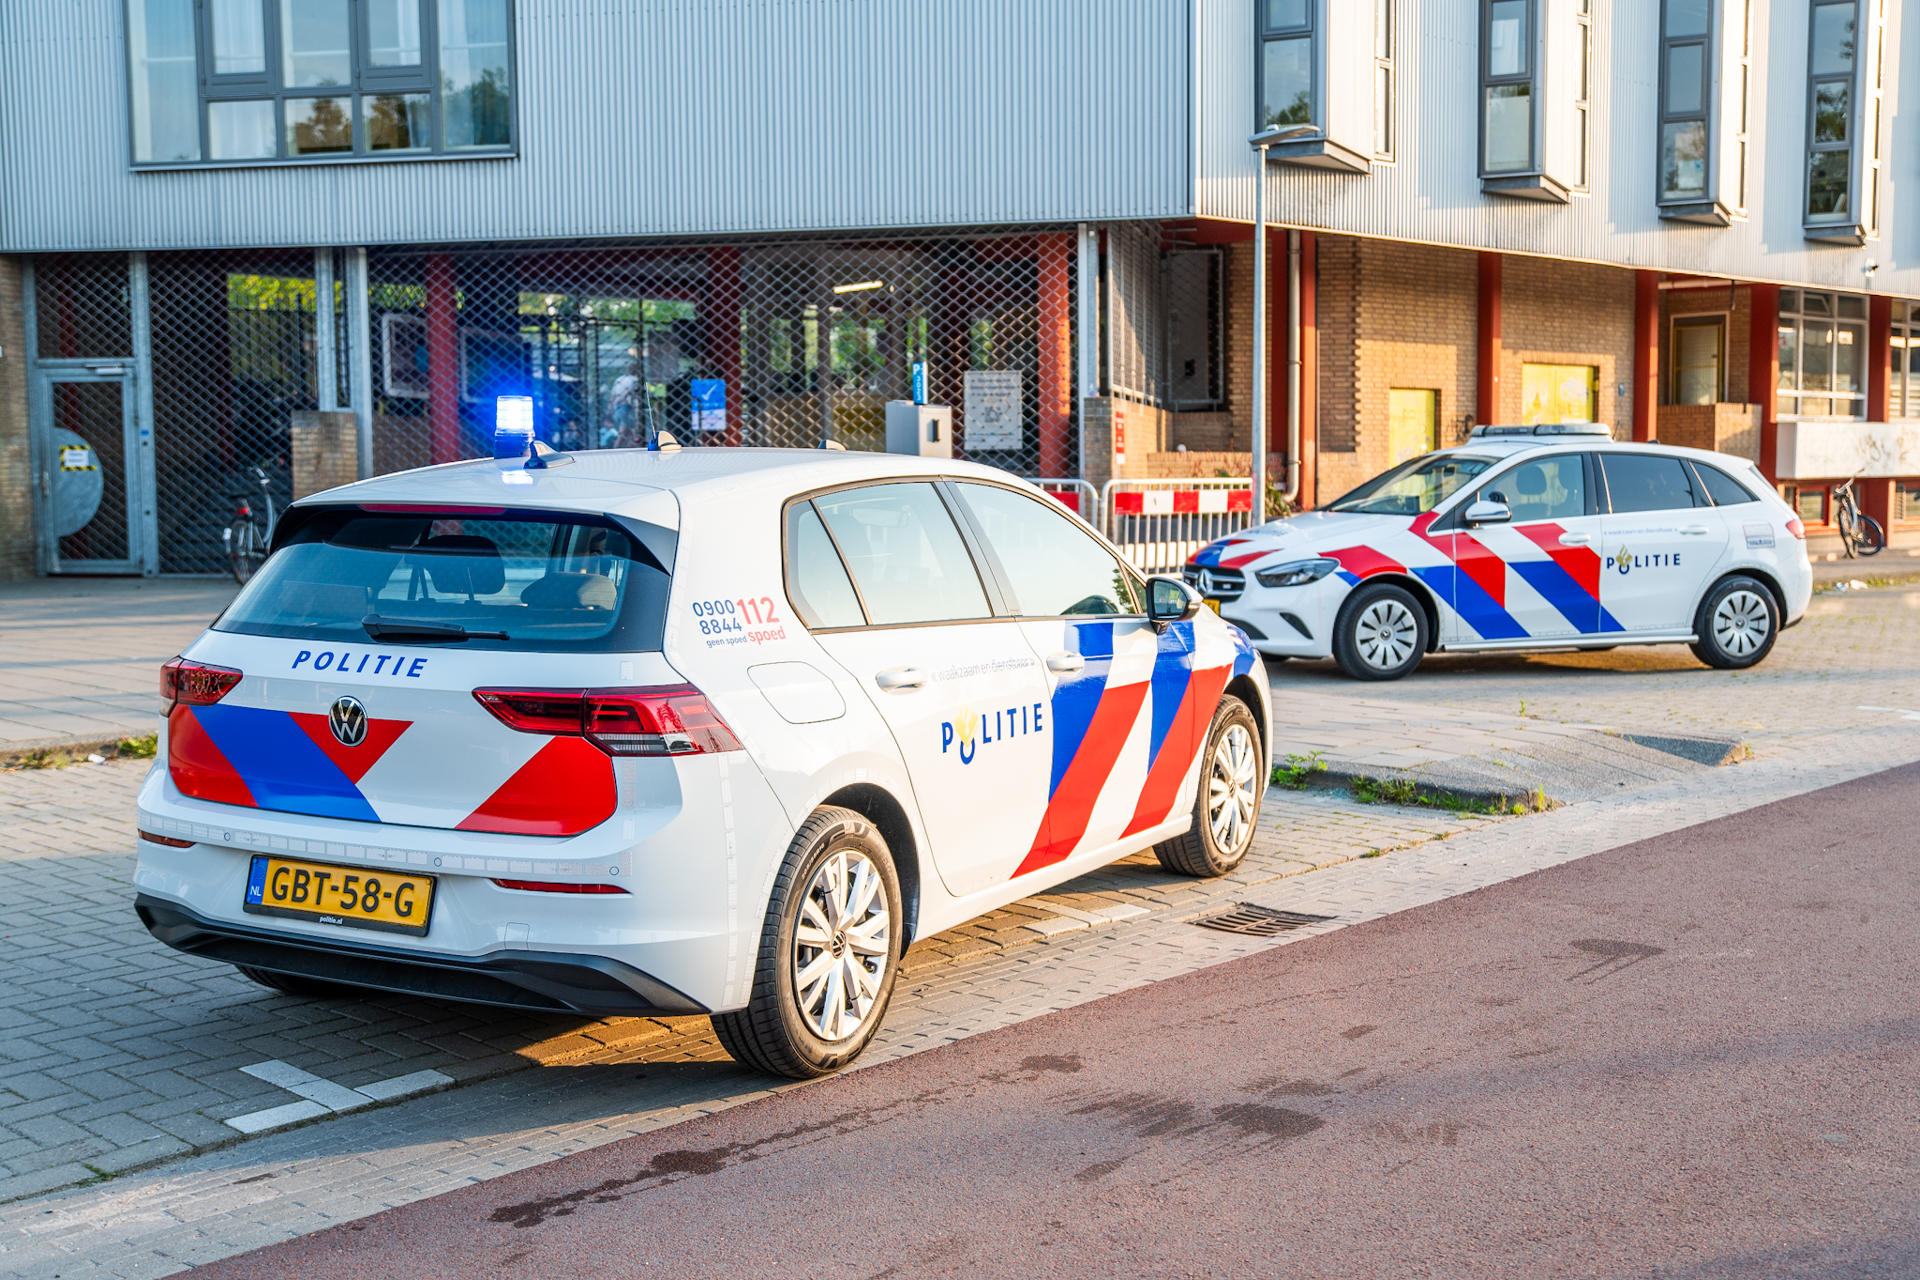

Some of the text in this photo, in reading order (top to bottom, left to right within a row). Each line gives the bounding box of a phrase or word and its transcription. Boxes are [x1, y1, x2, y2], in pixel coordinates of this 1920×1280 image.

[1606, 553, 1681, 575] POLITIE
[692, 599, 735, 617] 0900
[737, 597, 780, 625] 112
[699, 617, 742, 635] 8844
[747, 625, 786, 645] spoed
[706, 635, 748, 648] geen spoed
[291, 650, 429, 678] POLITIE
[941, 702, 1043, 765] POLITIE
[250, 885, 262, 897] NL
[271, 866, 415, 917] GBT-58-G
